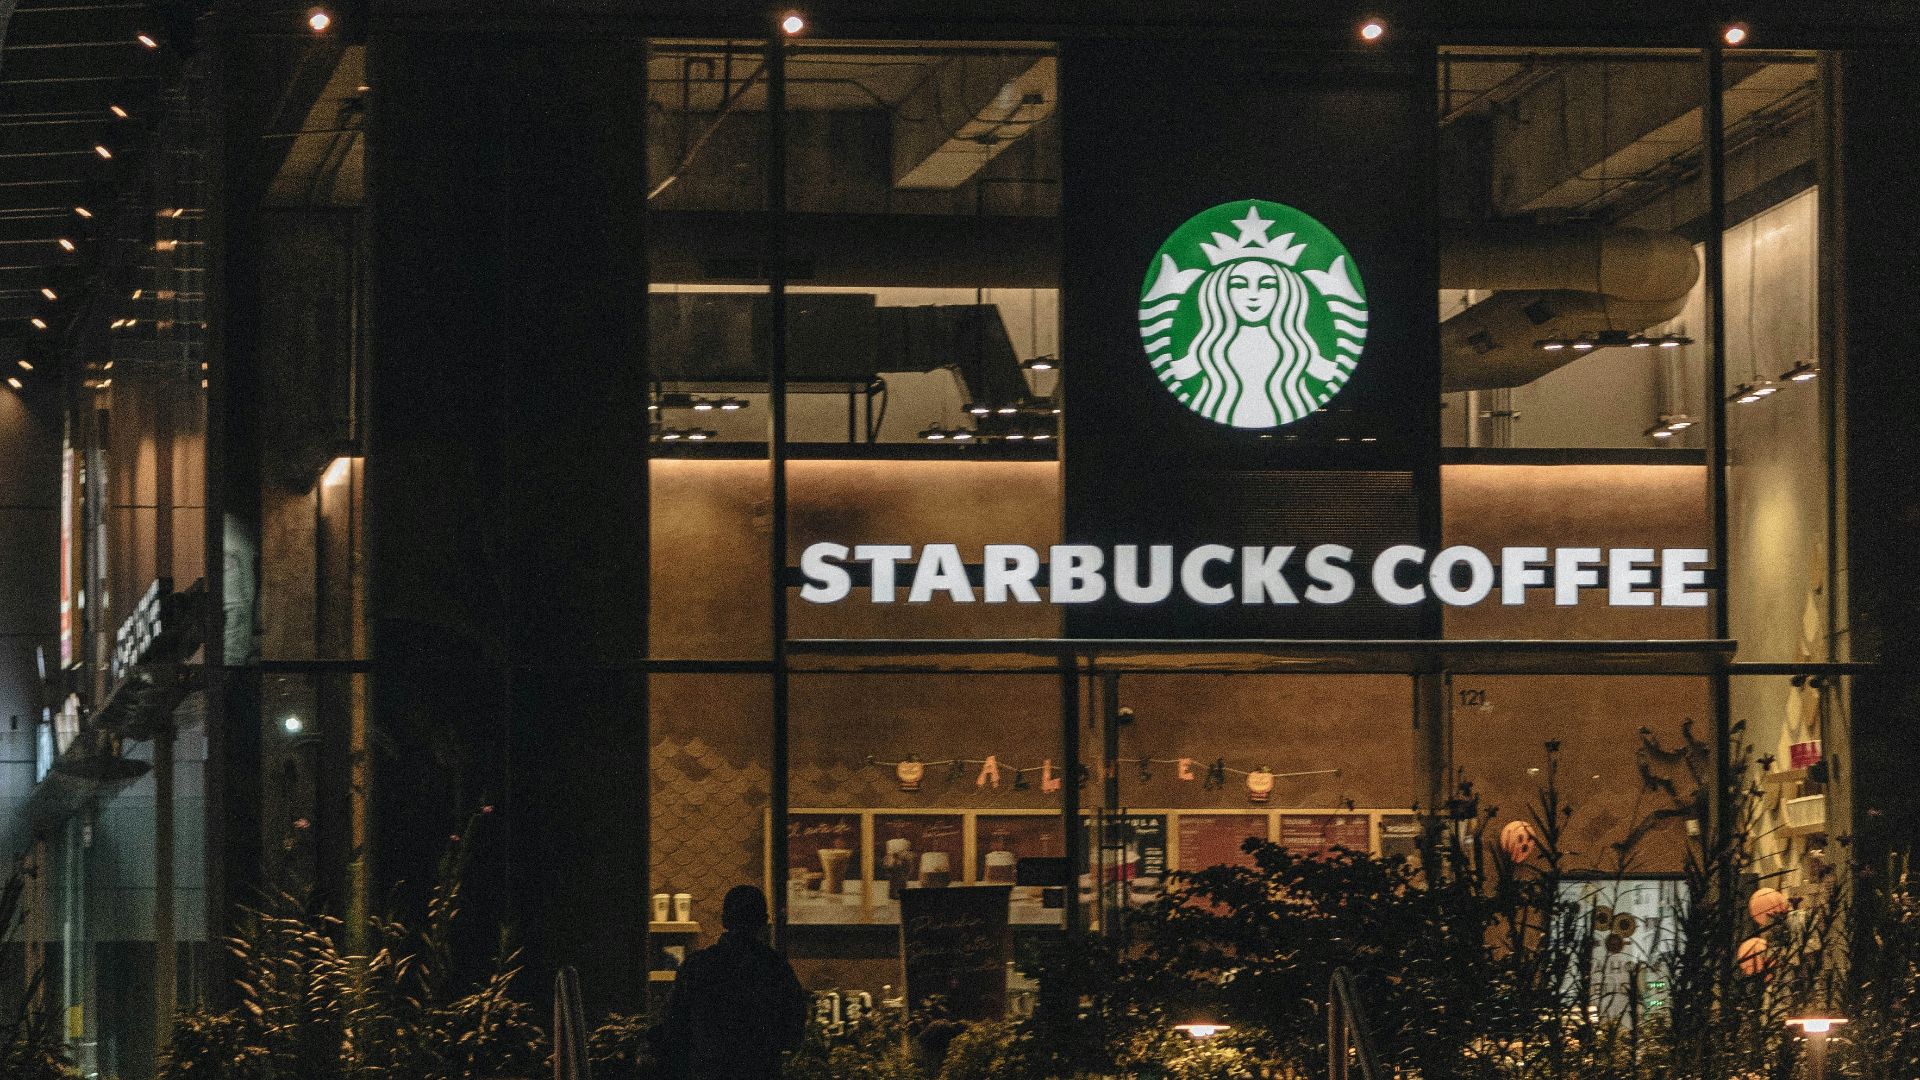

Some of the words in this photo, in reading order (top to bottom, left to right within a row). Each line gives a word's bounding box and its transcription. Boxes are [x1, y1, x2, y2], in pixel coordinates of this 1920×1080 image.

[800, 542, 1355, 604] STARBUCKS
[1372, 545, 1709, 606] COFFEE
[1459, 689, 1486, 706] 121
